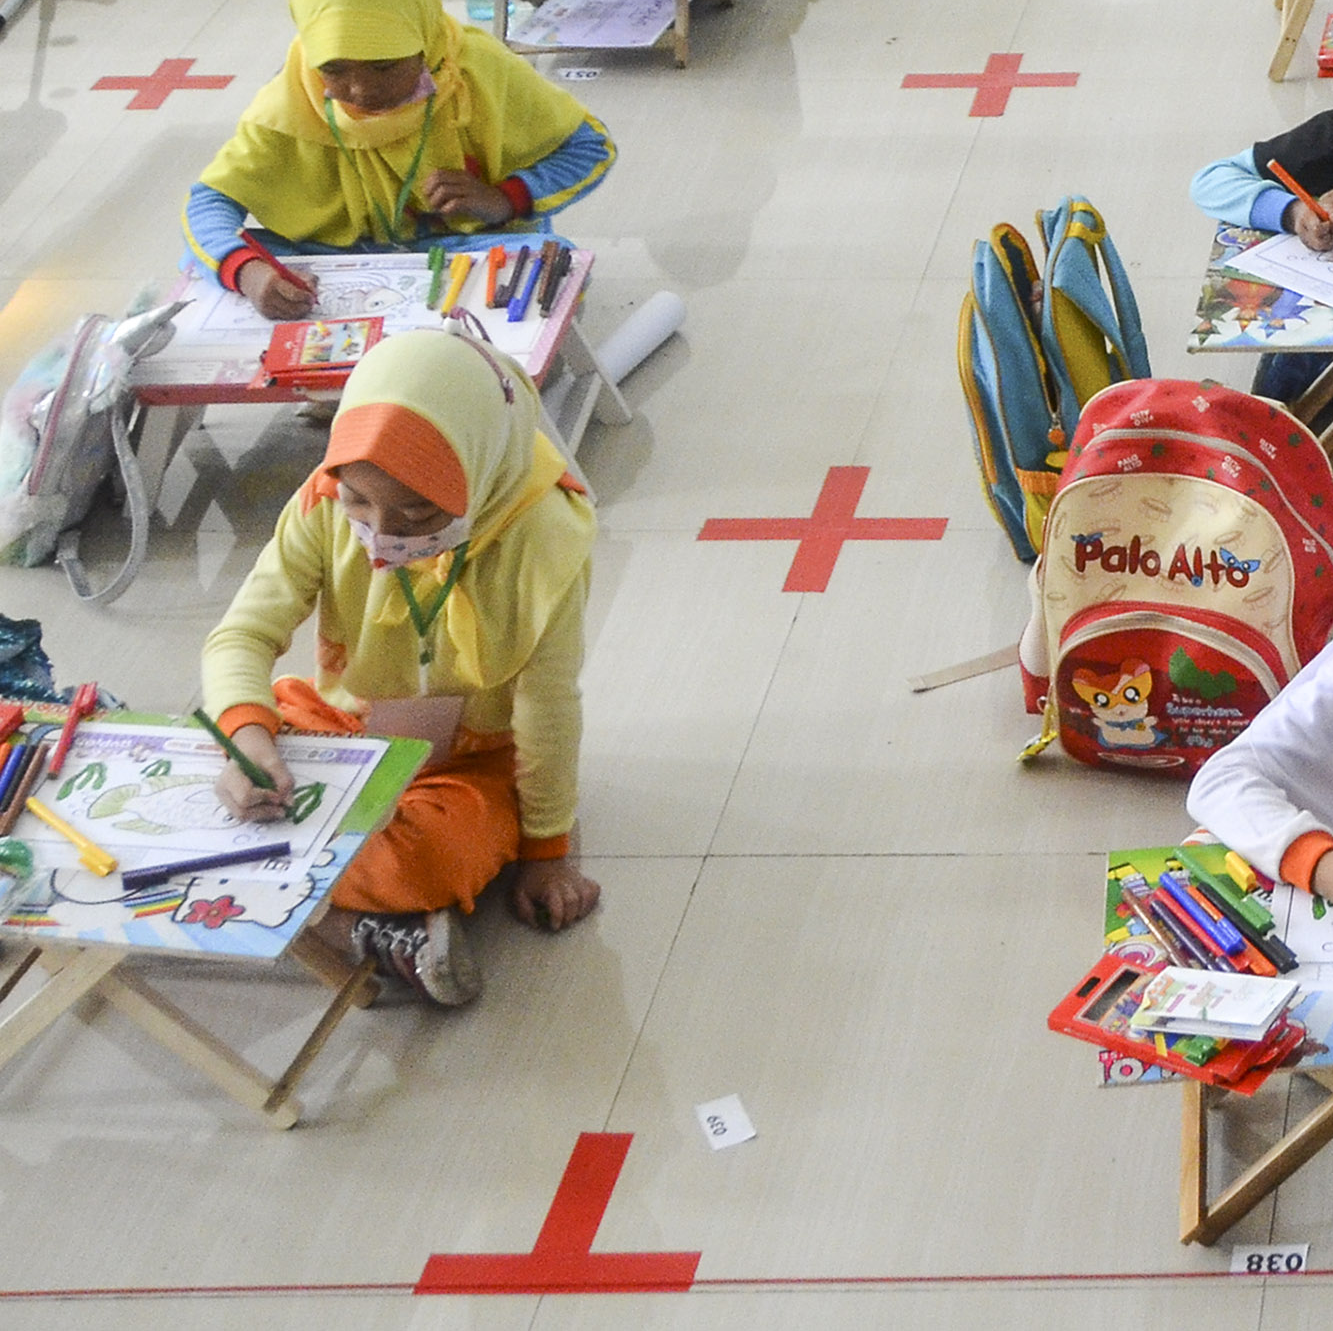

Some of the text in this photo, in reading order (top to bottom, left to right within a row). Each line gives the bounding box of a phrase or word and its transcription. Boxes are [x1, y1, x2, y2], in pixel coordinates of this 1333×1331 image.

[1074, 535, 1161, 577] Palo
[1168, 544, 1251, 587] Alto
[706, 1115, 728, 1136] 039
[1246, 1253, 1303, 1273] 038
